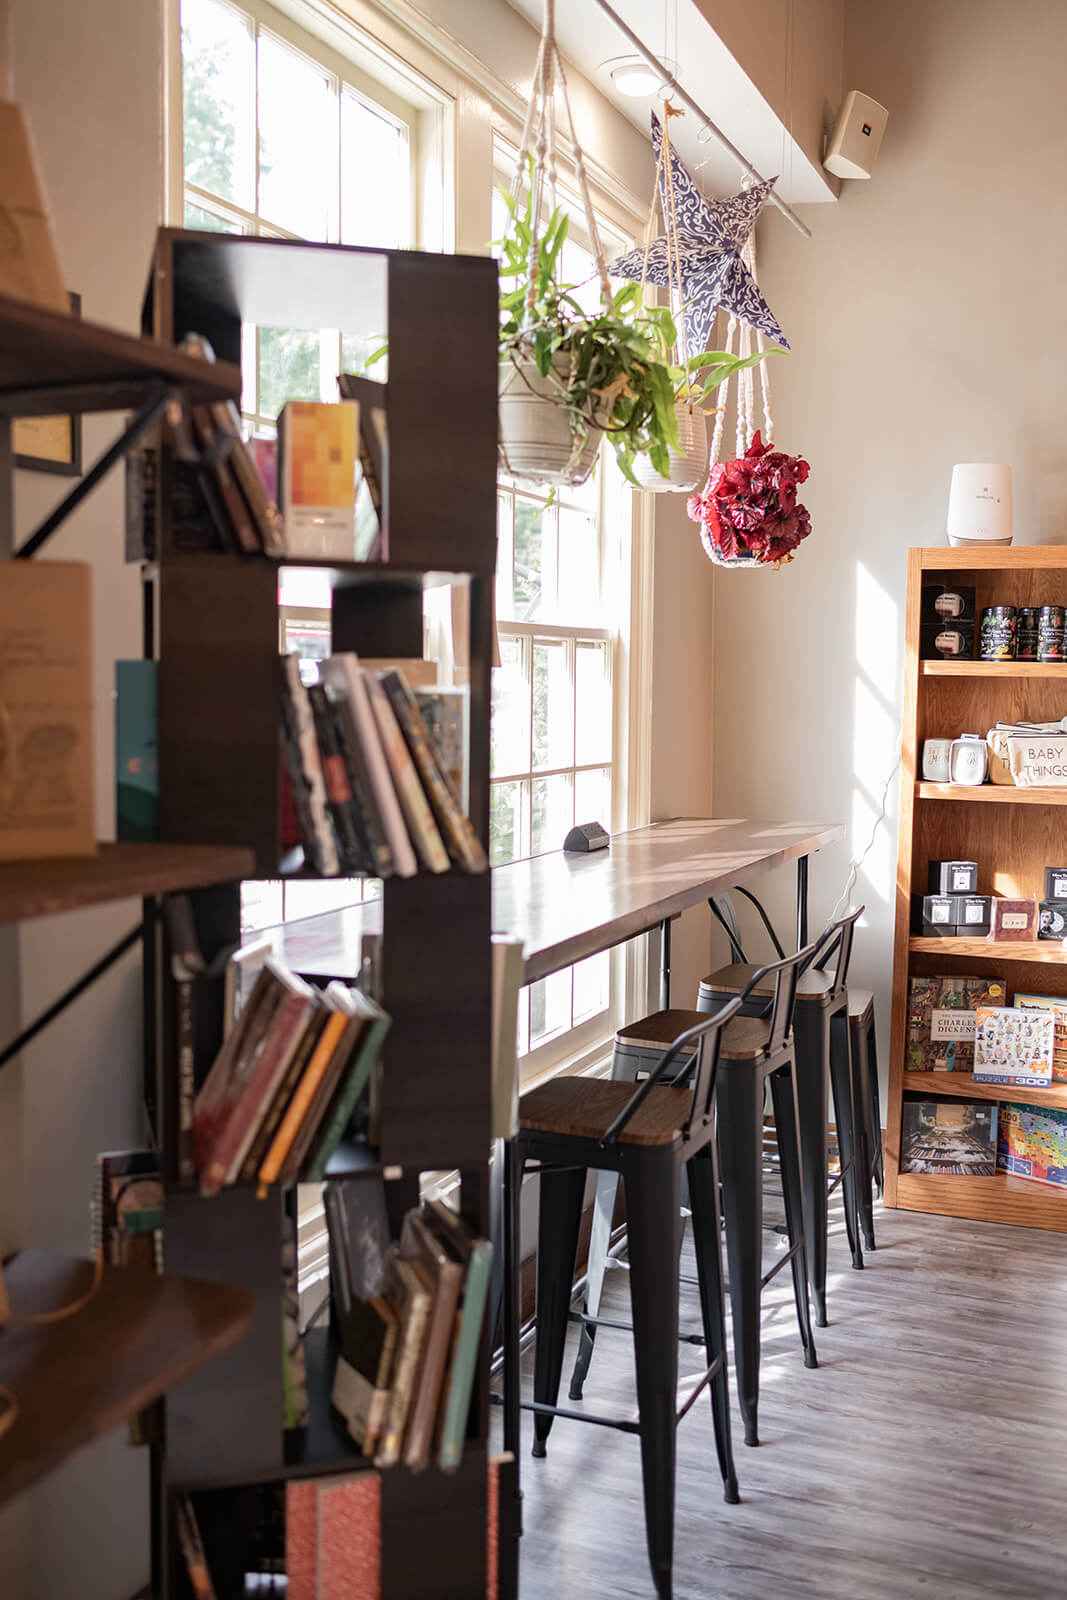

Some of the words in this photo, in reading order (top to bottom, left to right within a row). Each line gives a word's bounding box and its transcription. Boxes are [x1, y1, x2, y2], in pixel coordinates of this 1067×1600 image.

[1028, 748, 1064, 760] BABY
[1024, 764, 1067, 777] THINGS
[1015, 1077, 1049, 1086] 300
[1002, 1111, 1018, 1122] 100
